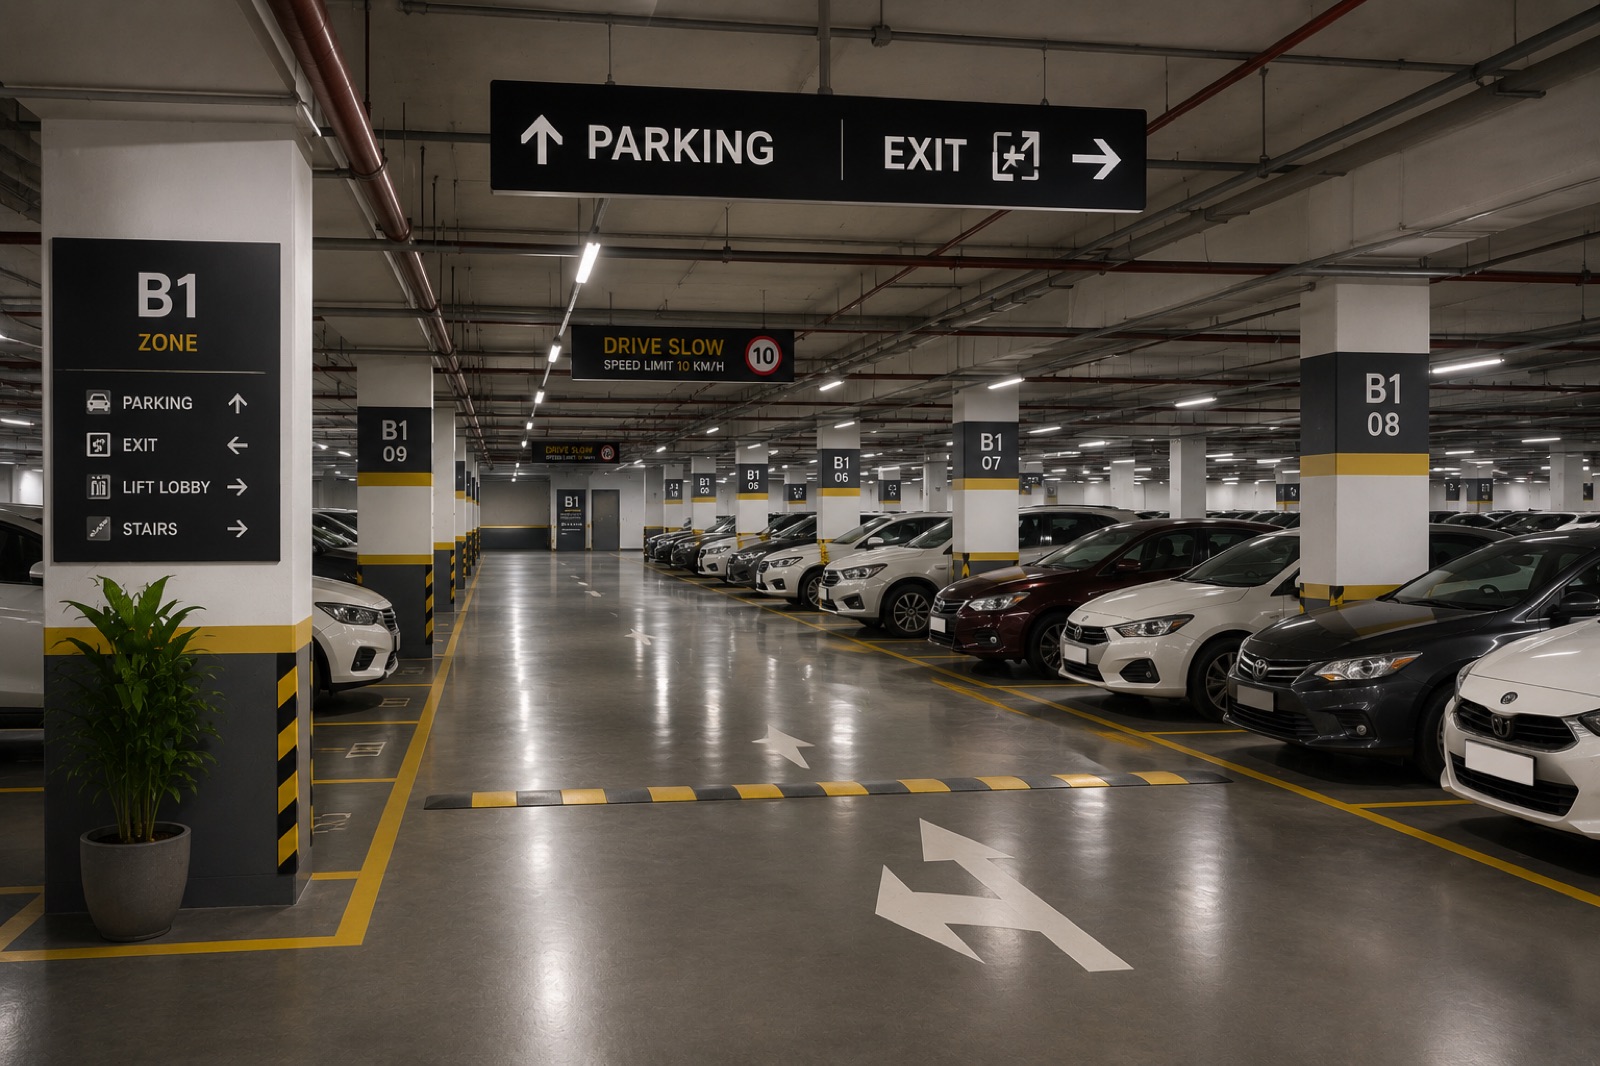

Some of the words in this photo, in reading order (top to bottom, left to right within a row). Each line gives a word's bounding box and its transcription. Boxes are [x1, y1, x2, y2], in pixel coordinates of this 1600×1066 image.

[587, 124, 774, 166] PARKING
[884, 135, 968, 173] EXIT
[137, 272, 197, 318] B1
[138, 333, 198, 352] ZONE
[604, 336, 662, 355] DRIVE
[669, 338, 725, 356] SLOW
[753, 347, 775, 365] 10
[604, 359, 641, 371] SPEED
[644, 360, 674, 372] LIMIT
[677, 360, 690, 372] 10
[693, 361, 725, 373] KM/H
[1366, 373, 1401, 404] B1
[123, 395, 193, 411] PARKING
[382, 420, 407, 441] B1
[1366, 411, 1400, 437] 08
[123, 437, 158, 452] EXIT
[980, 432, 1002, 452] B1
[383, 446, 407, 462] 09
[834, 456, 849, 469] B1
[981, 455, 1002, 471] 07
[747, 469, 760, 481] B1
[834, 472, 849, 483] 06
[123, 480, 155, 494] LIFT
[159, 480, 211, 494] LOBBY
[564, 495, 579, 508] B1
[123, 522, 178, 536] STAIRS
